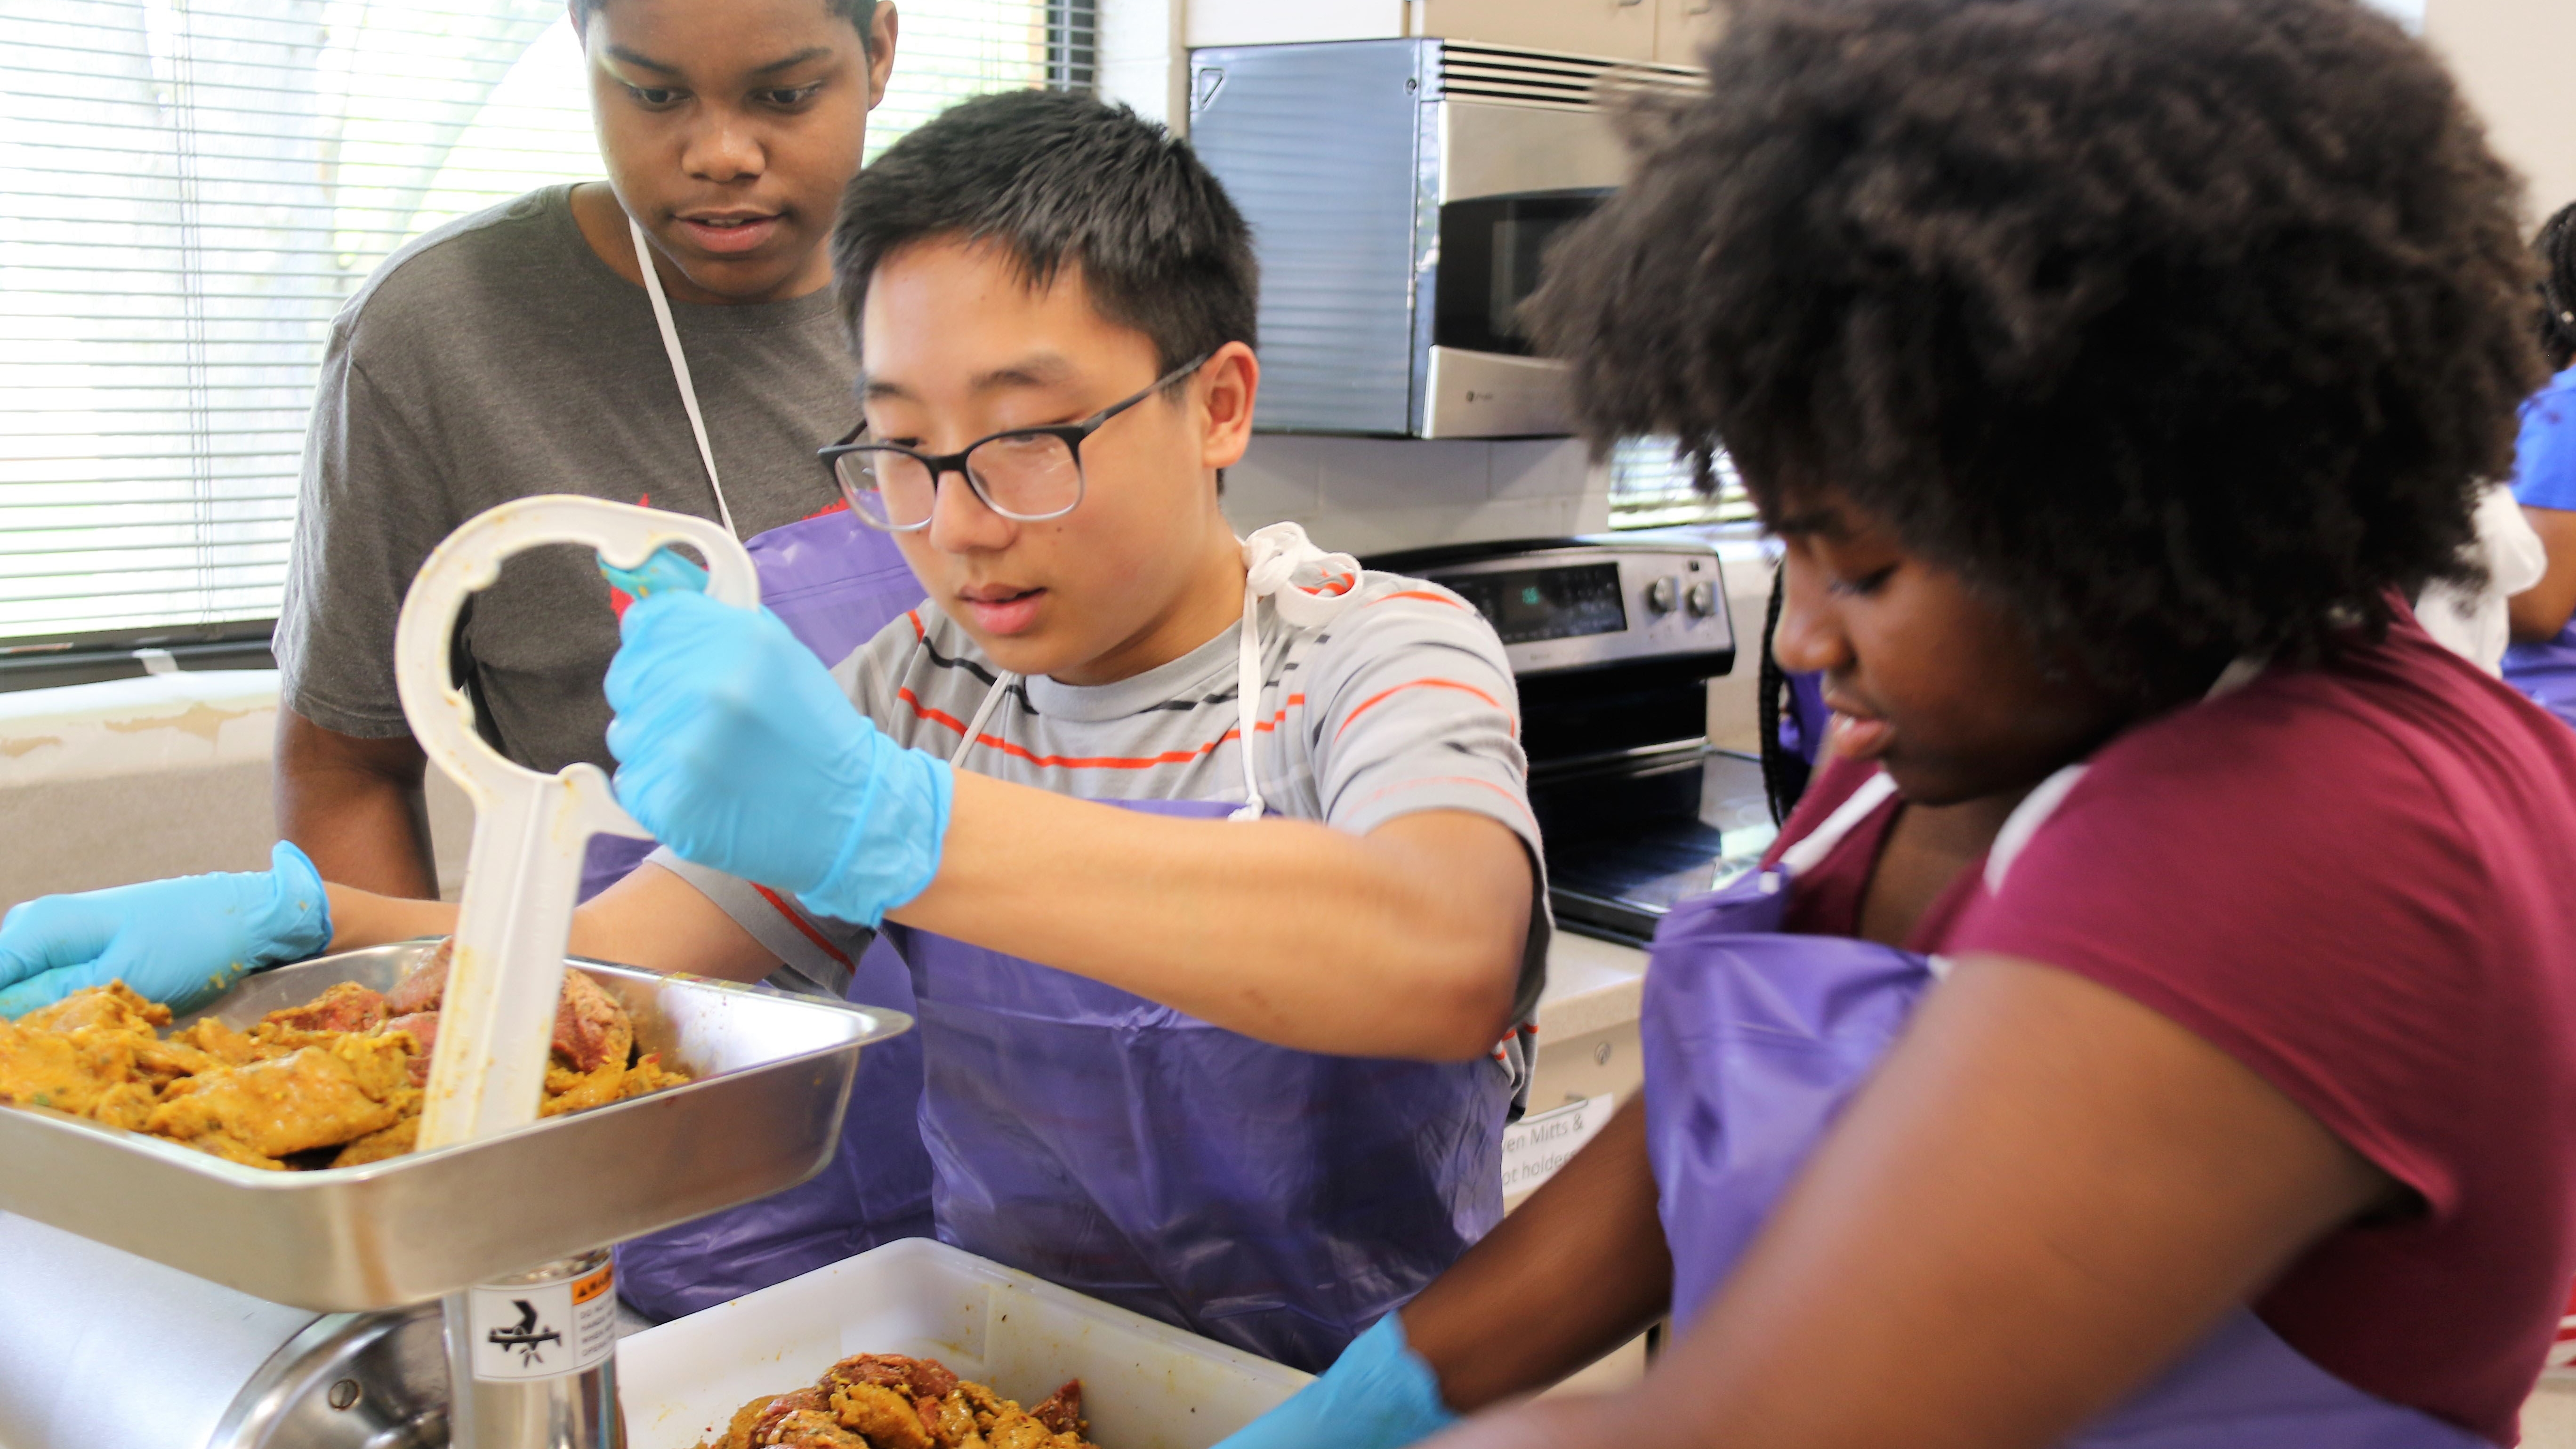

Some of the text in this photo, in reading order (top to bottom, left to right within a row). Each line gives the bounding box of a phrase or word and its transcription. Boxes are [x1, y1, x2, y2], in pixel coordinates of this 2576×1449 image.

[1502, 1112, 1584, 1152] ven Mitts &
[1502, 1151, 1575, 1186] ot holder
